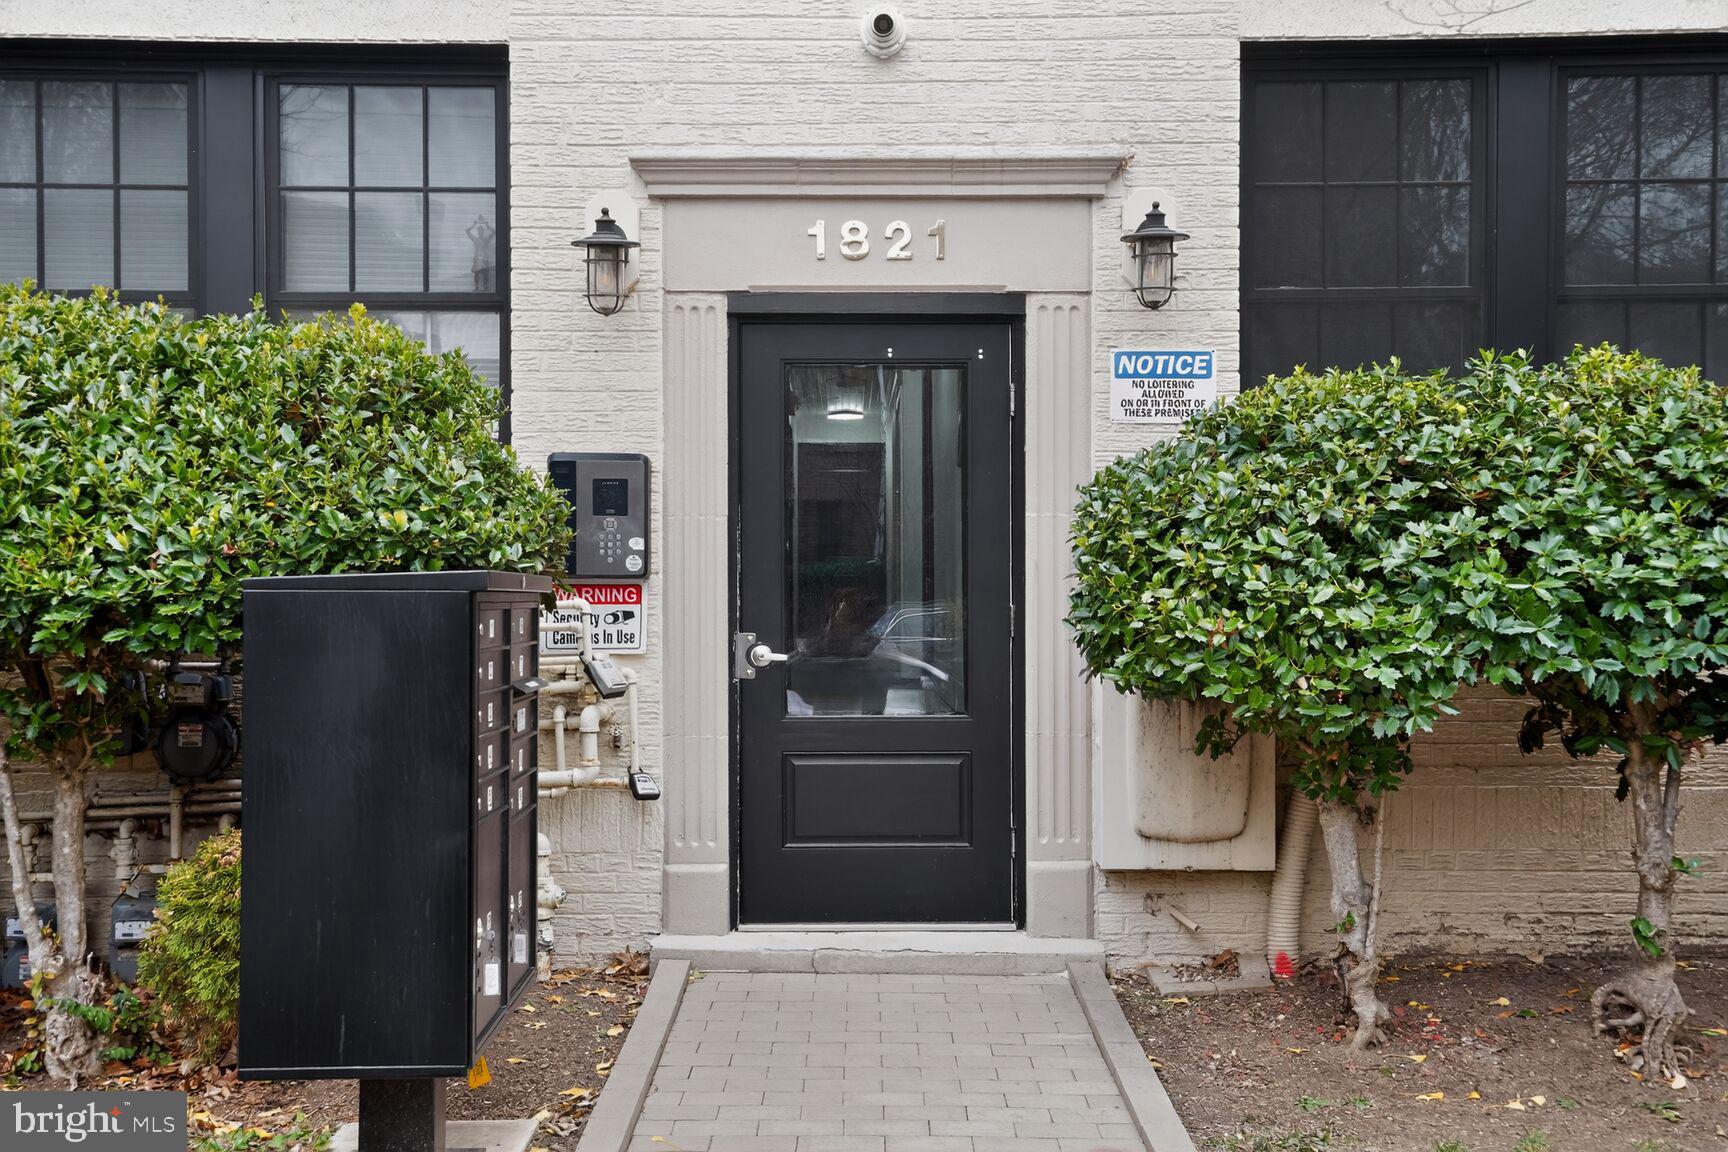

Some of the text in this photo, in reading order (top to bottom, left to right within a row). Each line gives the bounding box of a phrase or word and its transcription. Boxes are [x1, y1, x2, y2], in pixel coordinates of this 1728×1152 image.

[808, 219, 946, 261] 1821
[1118, 355, 1210, 375] NOTICE
[1132, 380, 1195, 389] NO LOITERING
[1141, 389, 1185, 399] ALLOWED
[1120, 399, 1134, 408] ON
[1136, 399, 1149, 408] OR
[1162, 399, 1192, 408] FRONT
[1194, 399, 1206, 408] OF
[1123, 408, 1153, 417] THESE
[553, 610, 600, 628] Secuty
[553, 629, 636, 645] Cams In Use
